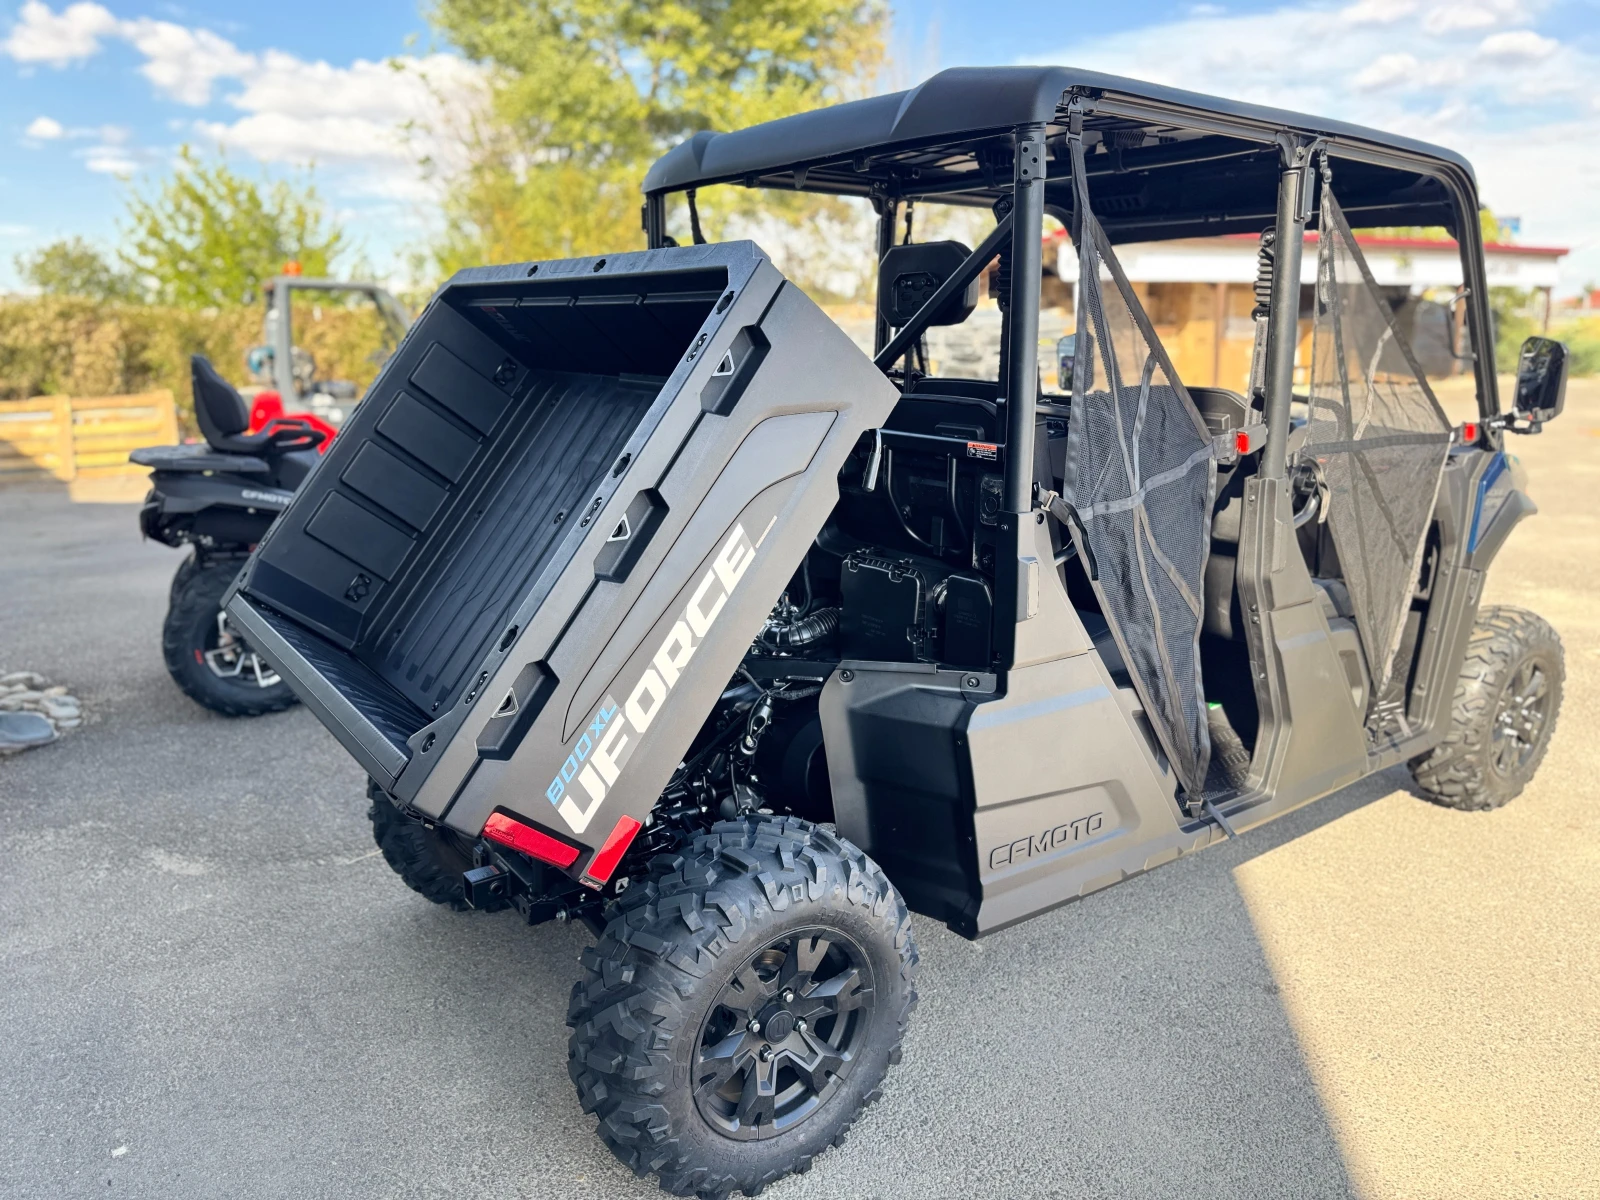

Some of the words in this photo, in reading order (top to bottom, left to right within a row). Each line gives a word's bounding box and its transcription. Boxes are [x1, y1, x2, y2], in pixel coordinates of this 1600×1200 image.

[557, 522, 756, 834] UFORCE
[548, 703, 618, 805] 800XL
[989, 812, 1103, 870] CFMOTO
